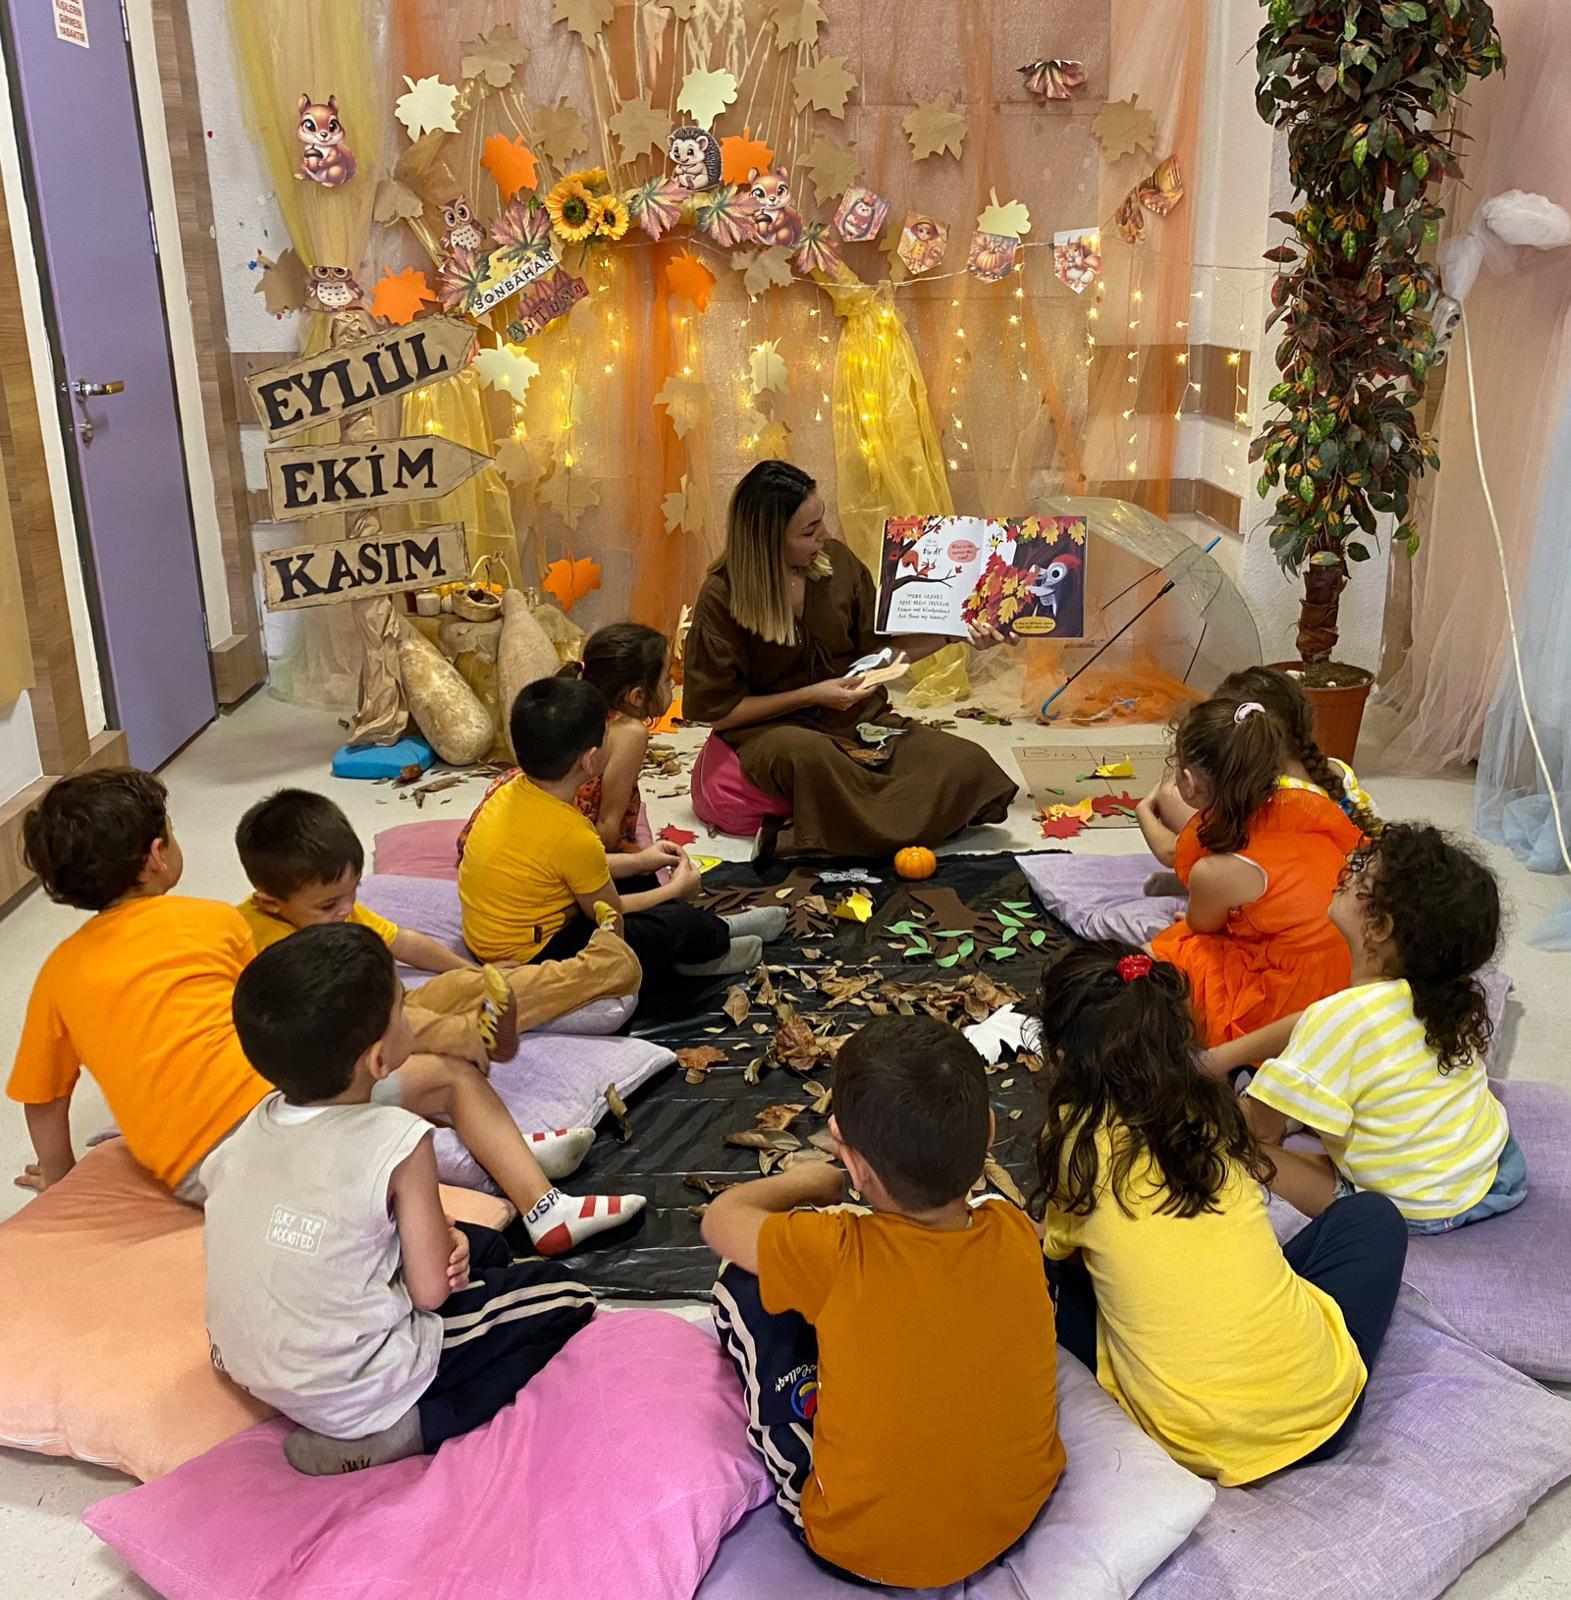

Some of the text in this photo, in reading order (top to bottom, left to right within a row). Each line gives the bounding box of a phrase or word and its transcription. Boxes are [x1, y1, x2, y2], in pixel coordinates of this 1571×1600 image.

[474, 252, 554, 310] SONBAHAR
[258, 332, 449, 431] EYLÜL
[280, 445, 438, 509] EKİM
[271, 536, 447, 602] KASIM
